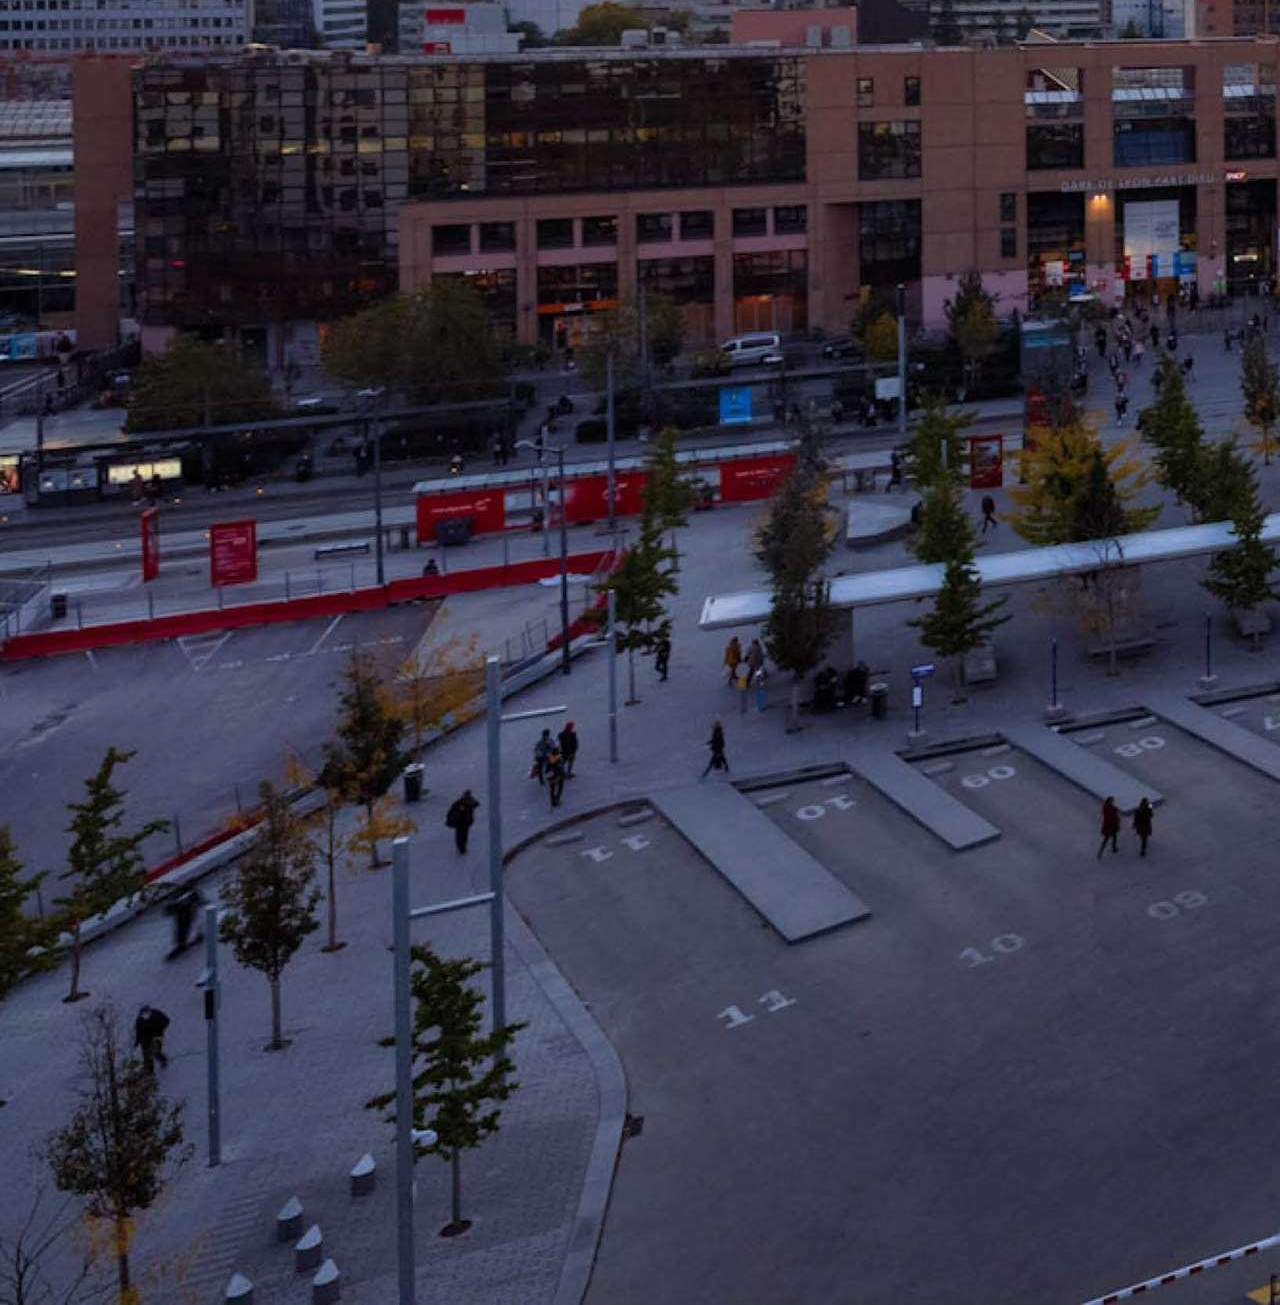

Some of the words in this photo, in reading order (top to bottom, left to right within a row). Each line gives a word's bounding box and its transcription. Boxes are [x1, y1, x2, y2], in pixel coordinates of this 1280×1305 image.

[1118, 177, 1151, 189] LYON
[1114, 737, 1165, 756] 08
[961, 767, 1015, 788] 09
[796, 796, 855, 820] 10
[581, 835, 650, 861] 11
[1148, 891, 1206, 919] 09
[960, 934, 1023, 967] 10
[717, 990, 796, 1029] 11
